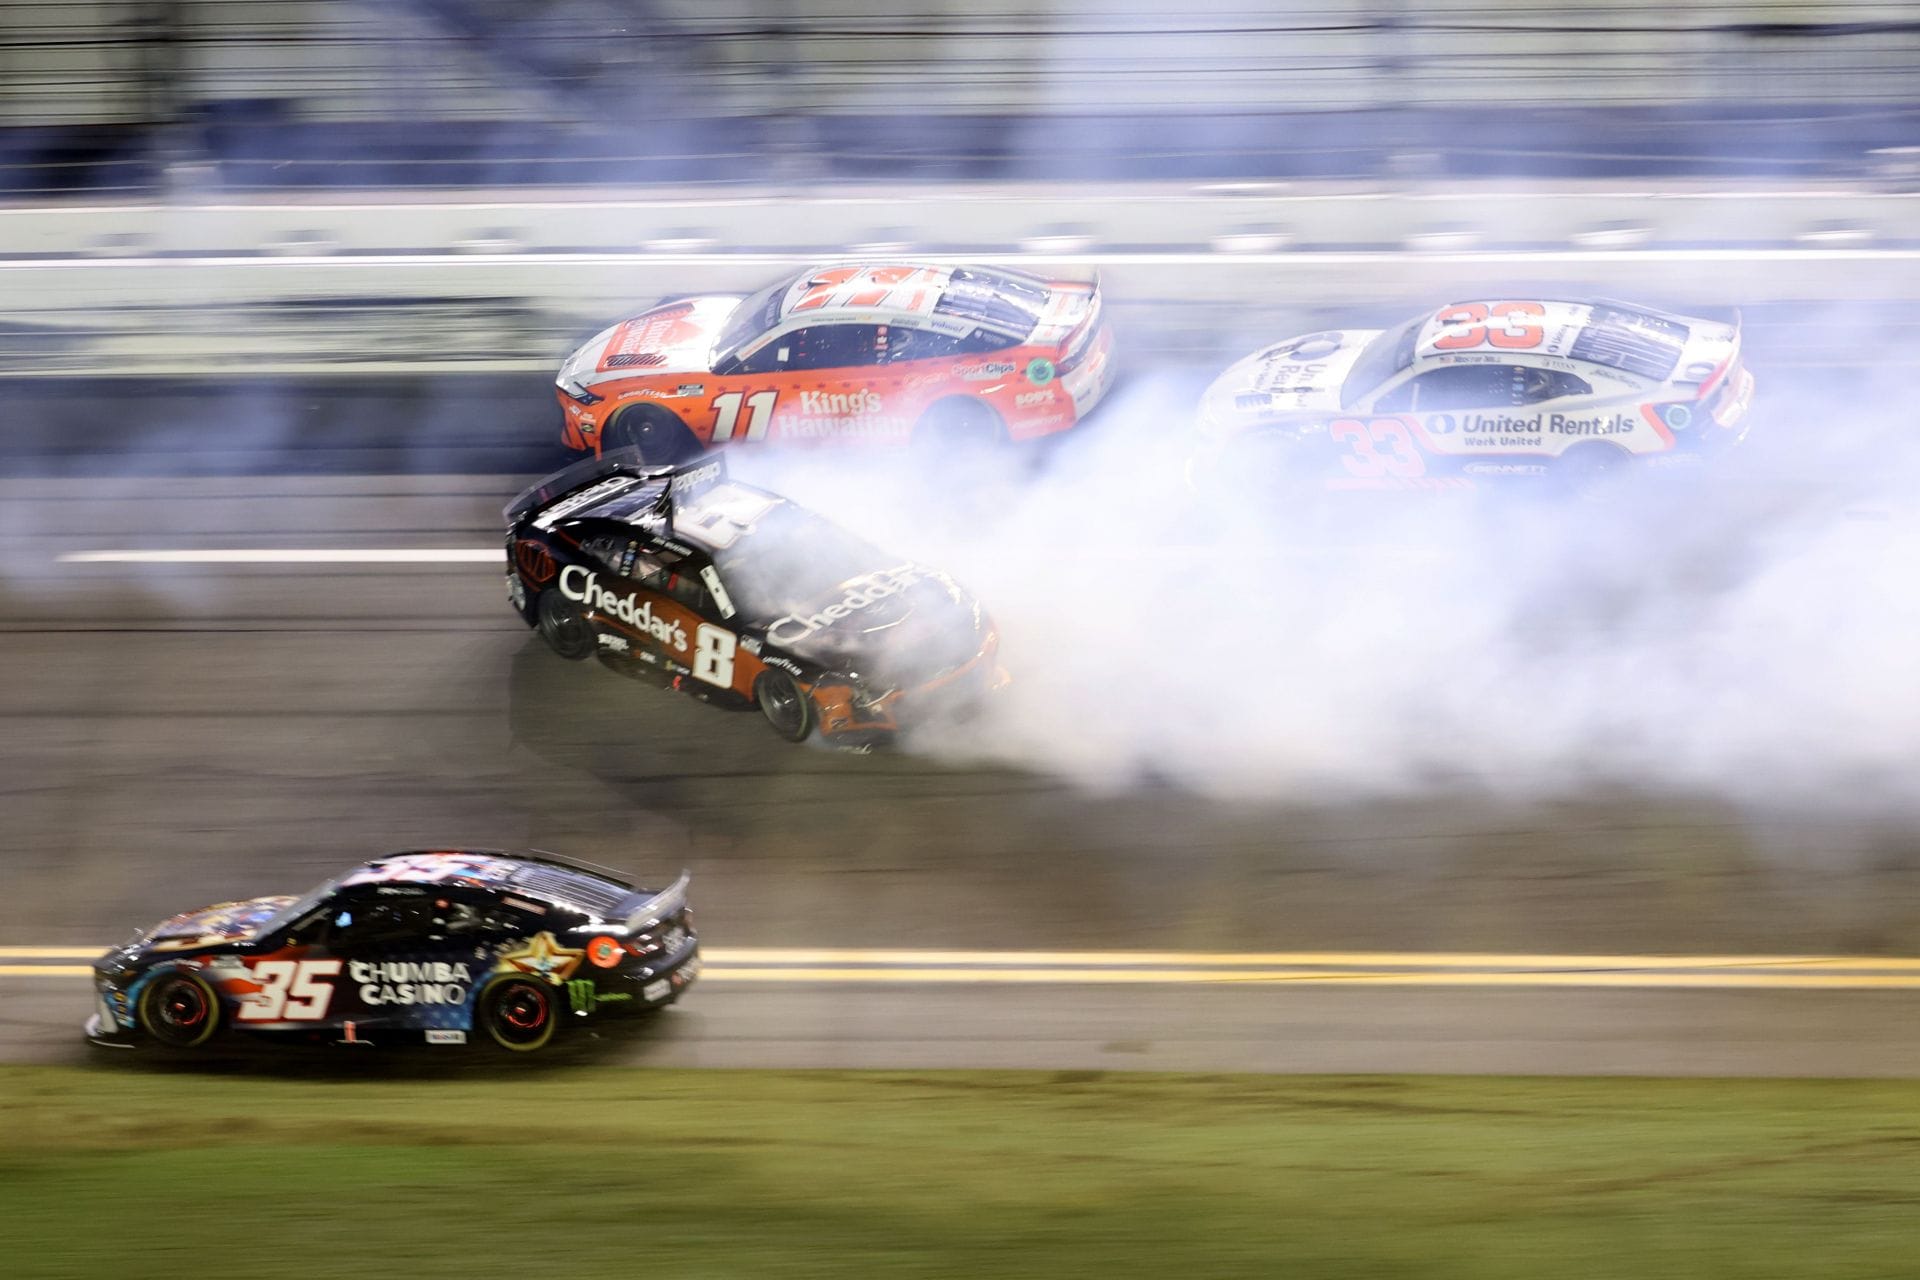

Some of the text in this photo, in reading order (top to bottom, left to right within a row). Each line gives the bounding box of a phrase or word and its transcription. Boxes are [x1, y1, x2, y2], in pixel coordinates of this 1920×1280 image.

[1433, 302, 1546, 349] 33
[710, 390, 778, 442] 11
[799, 389, 882, 415] King's
[1463, 414, 1634, 435] United Rentals
[1328, 417, 1426, 478] 33
[1464, 437, 1542, 447] Work United
[558, 564, 689, 652] Cheddar's
[692, 622, 738, 689] 8
[237, 960, 343, 1020] 35
[350, 960, 472, 983] CHUMBA
[358, 984, 468, 1006] CASINO
